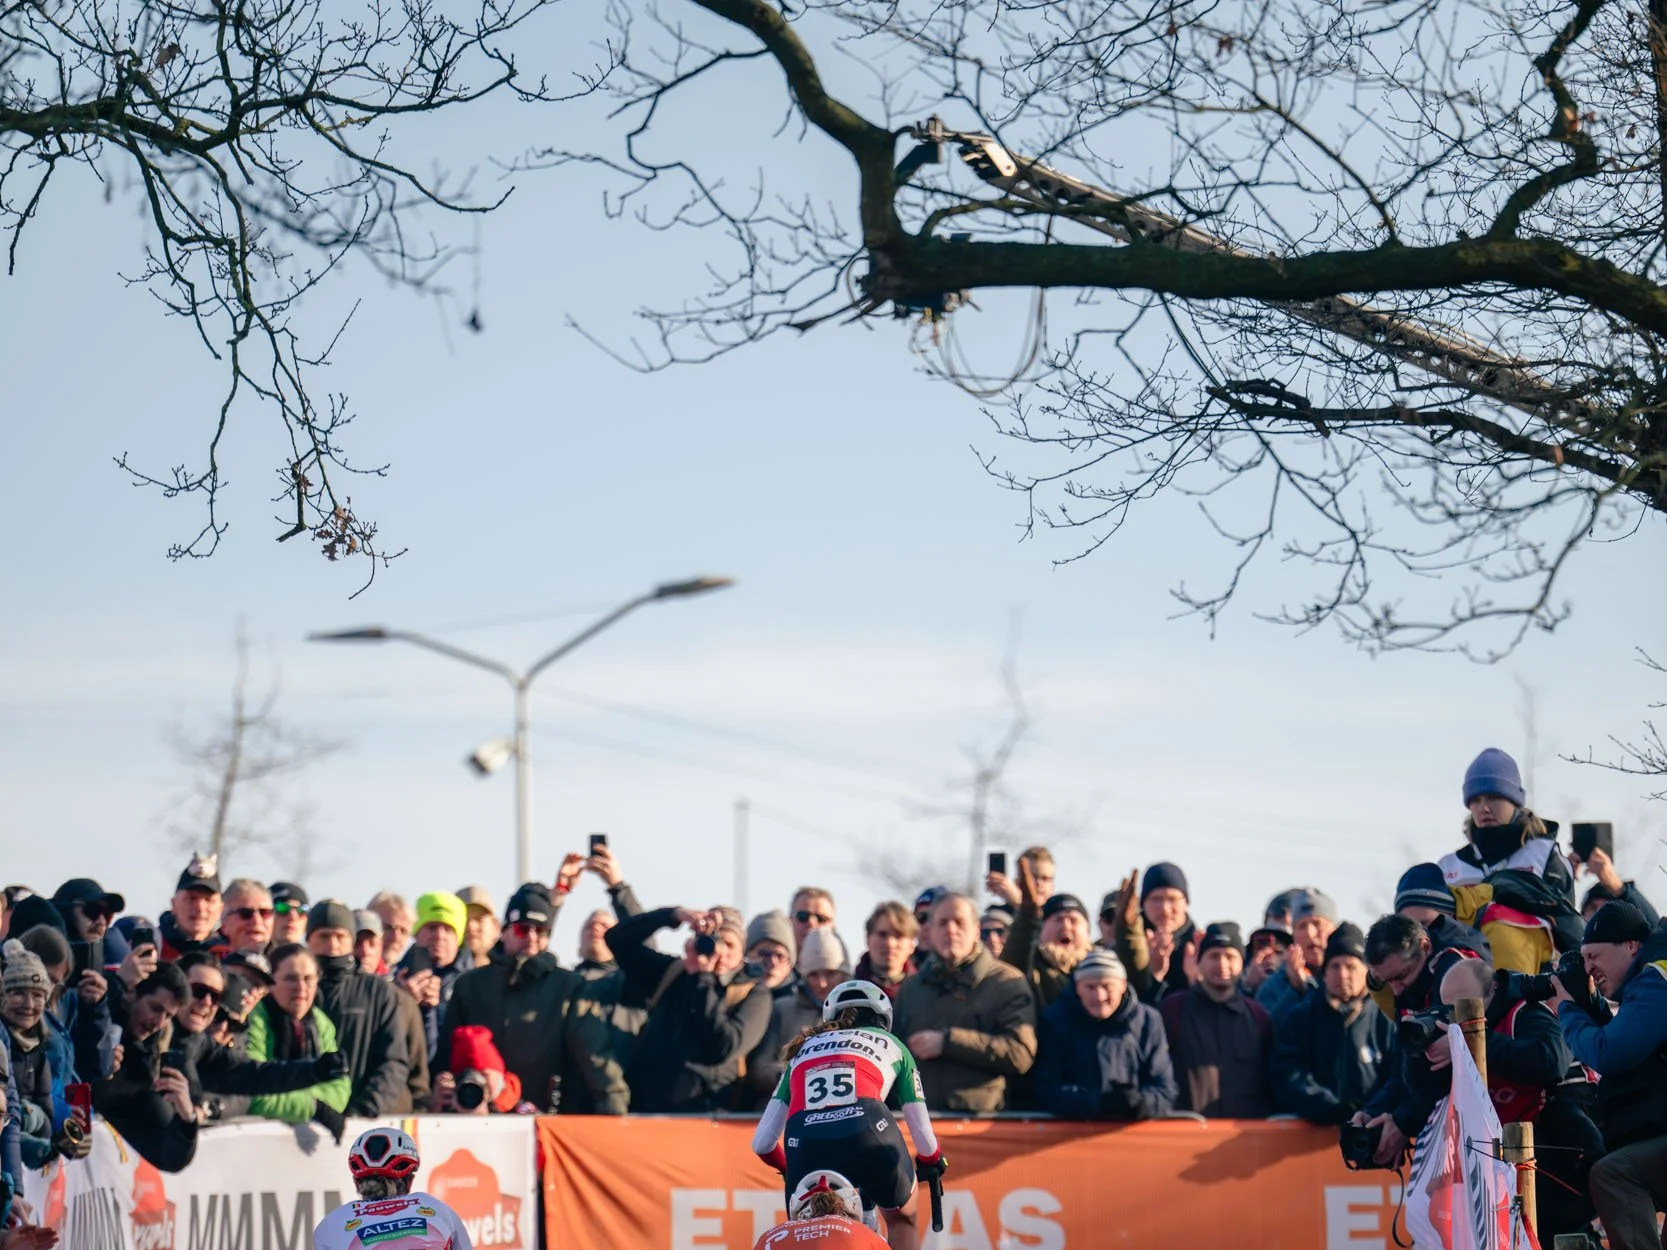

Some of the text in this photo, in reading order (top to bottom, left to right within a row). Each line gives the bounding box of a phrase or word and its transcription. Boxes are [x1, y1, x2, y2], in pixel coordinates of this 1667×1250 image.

[808, 1073, 854, 1103] 35
[362, 1219, 425, 1237] ALTEZ
[794, 1224, 851, 1234] PREMIER
[795, 1231, 829, 1242] TECH
